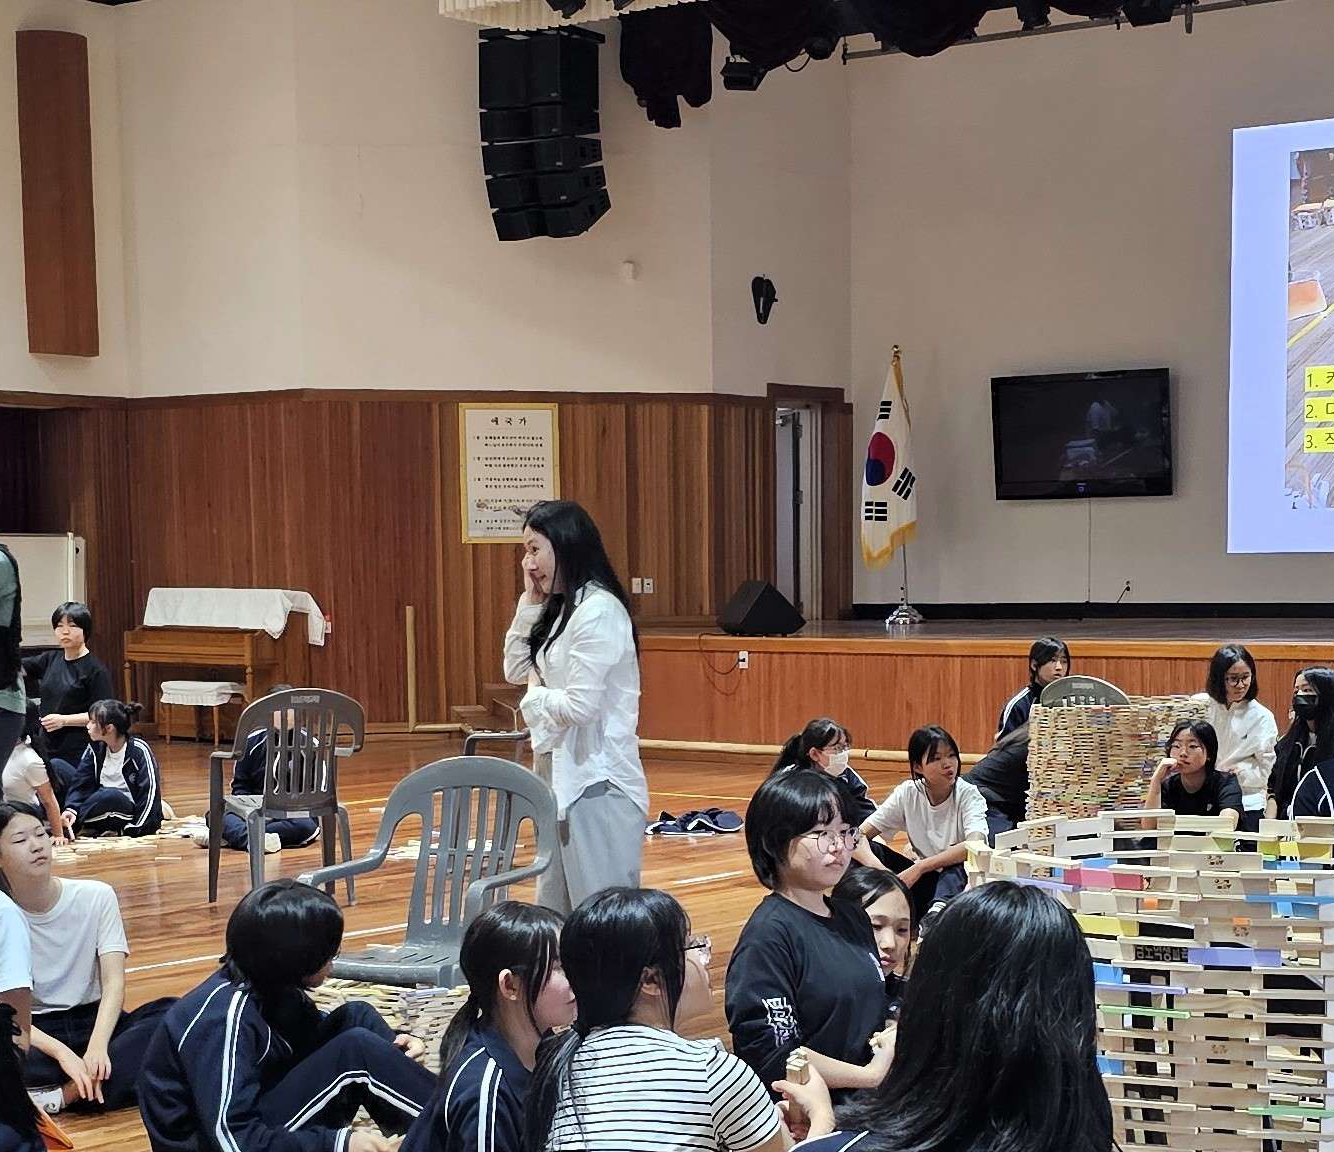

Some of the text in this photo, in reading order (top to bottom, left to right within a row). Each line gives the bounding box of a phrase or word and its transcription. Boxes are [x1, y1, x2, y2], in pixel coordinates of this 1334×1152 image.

[1307, 373, 1319, 388] 1.
[1305, 404, 1318, 419] 2.
[1305, 434, 1318, 449] 3.
